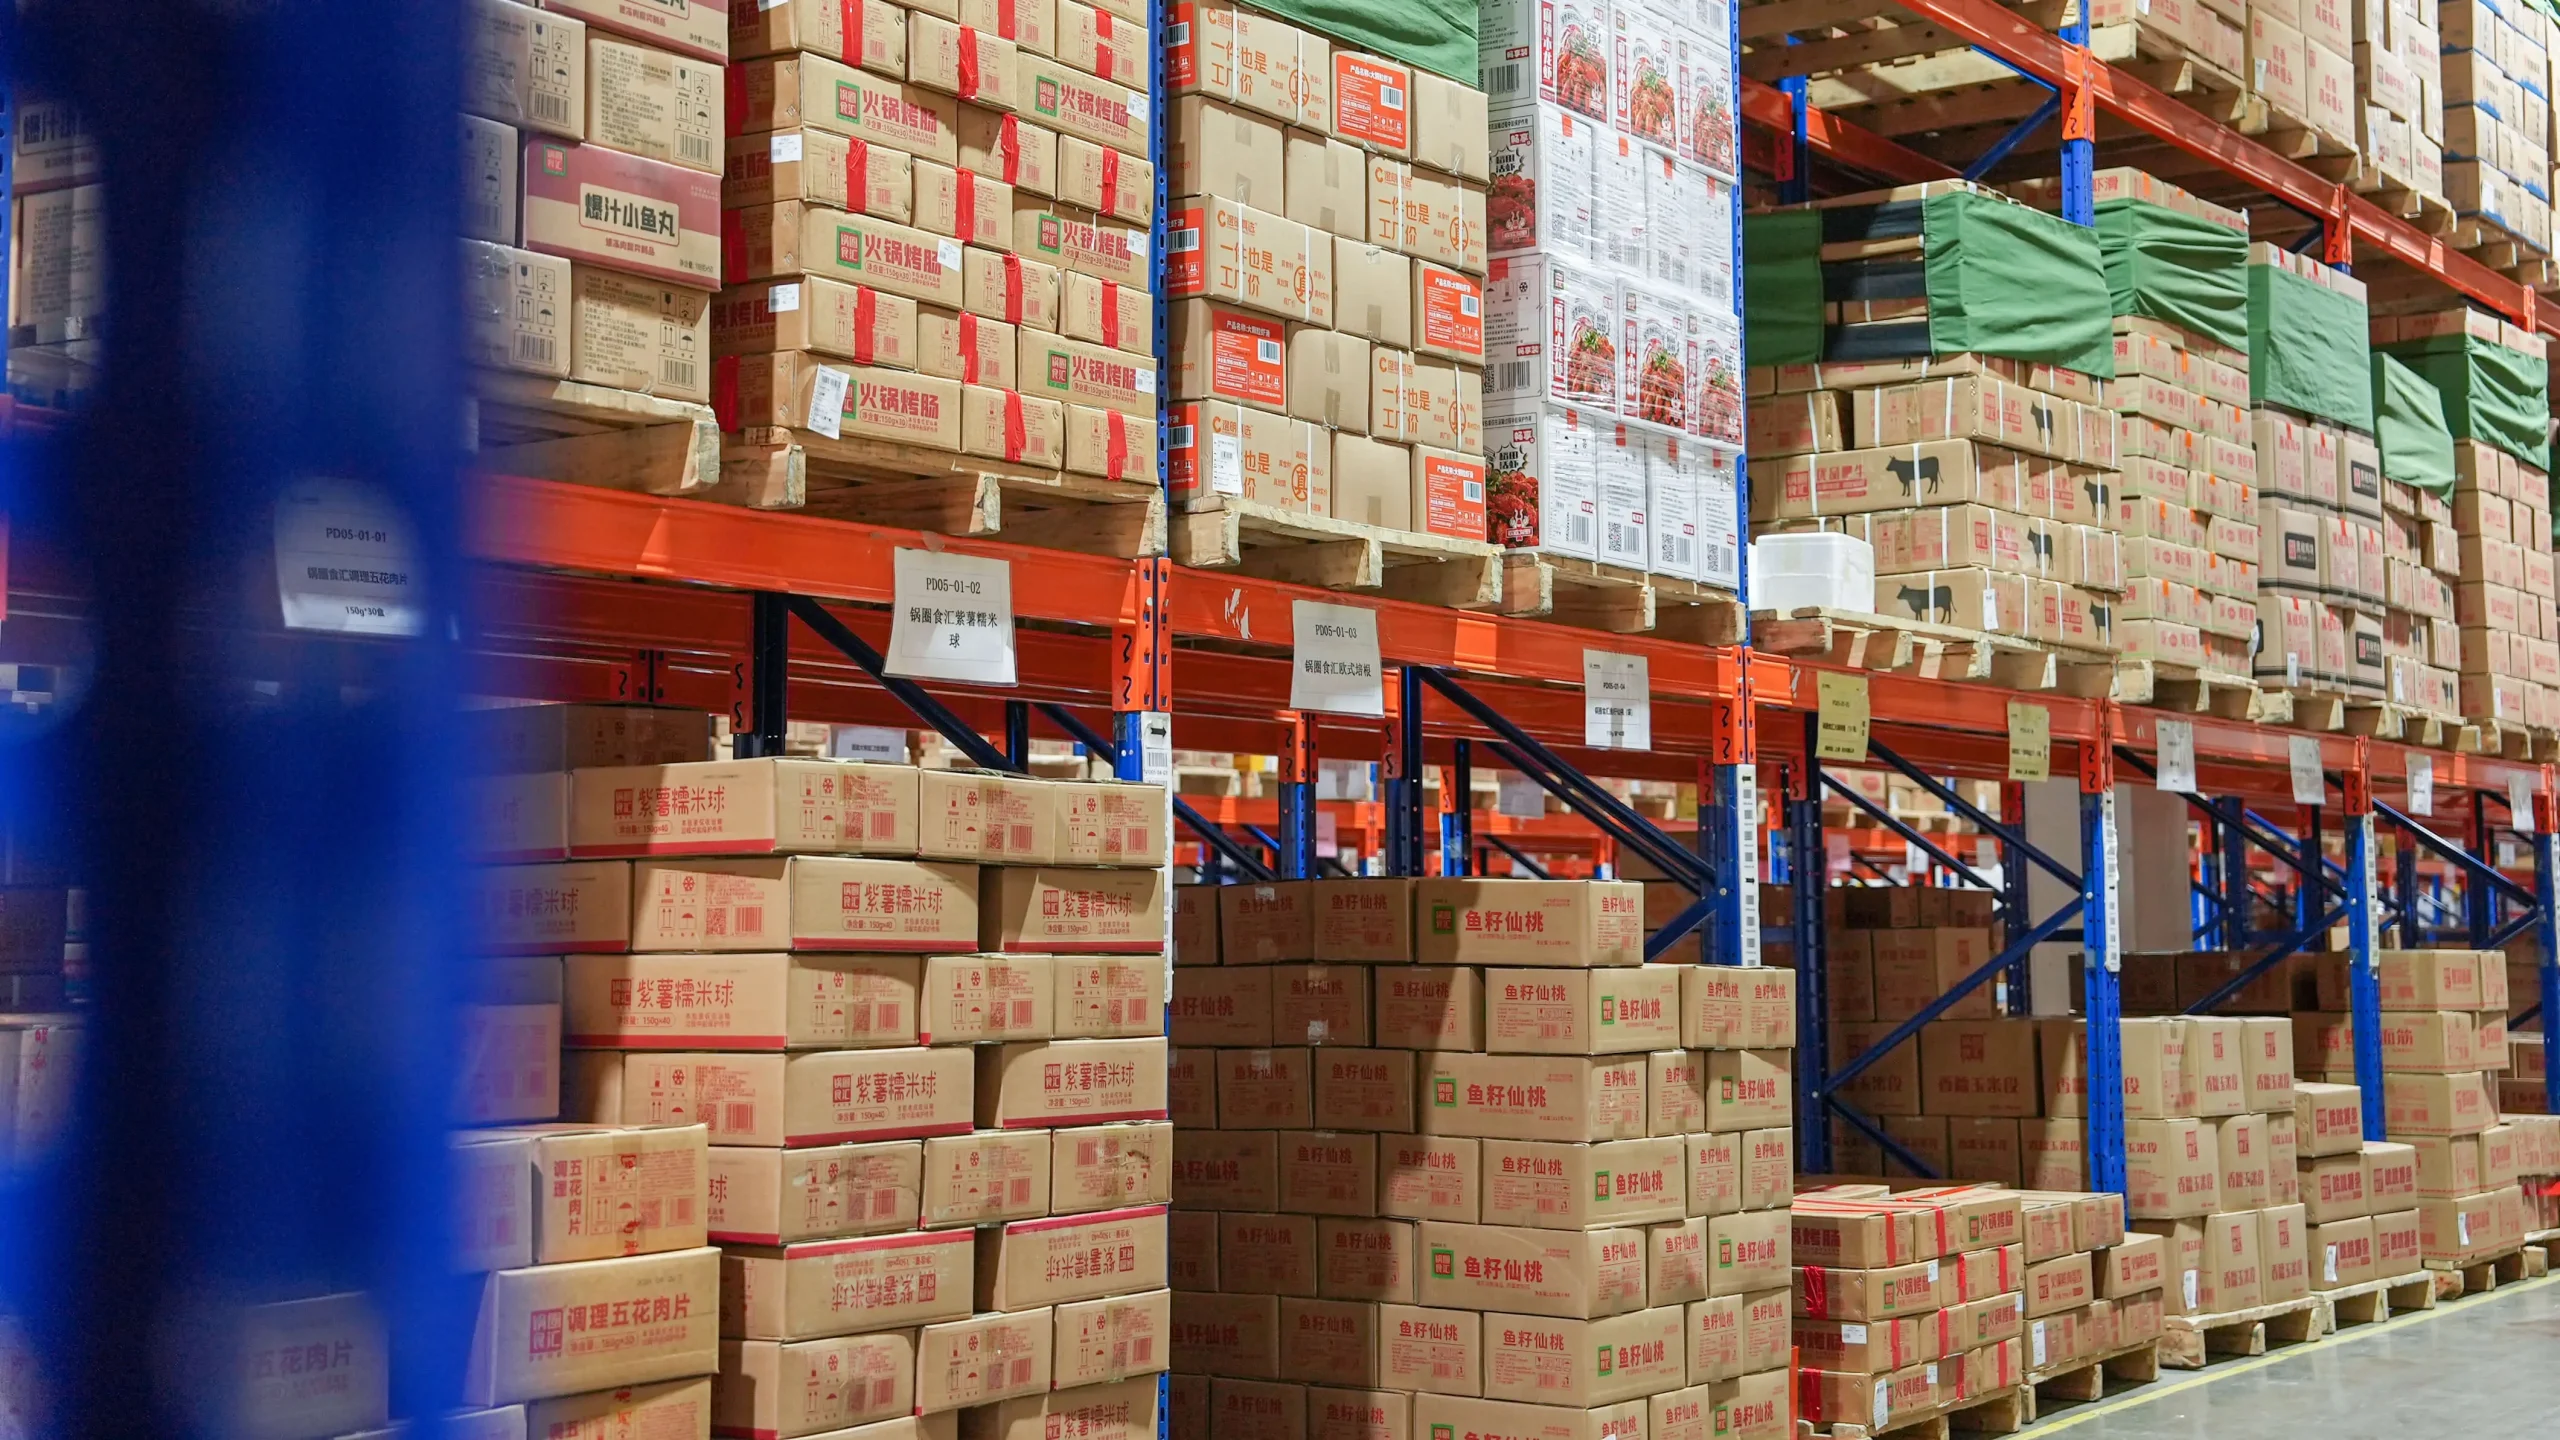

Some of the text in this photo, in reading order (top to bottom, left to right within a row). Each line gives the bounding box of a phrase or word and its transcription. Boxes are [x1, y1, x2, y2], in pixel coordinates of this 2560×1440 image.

[1211, 62, 1253, 96] 工厂价
[863, 89, 937, 134] 火锅烤肠
[1061, 83, 1129, 128] 火锅烤肠
[584, 192, 676, 238] 爆汁小鱼丸
[1063, 221, 1131, 261] 火锅烤肠
[1379, 218, 1417, 246] 工厂价
[865, 234, 941, 275] 火锅烤肠
[1220, 265, 1260, 298] 工厂价
[1072, 355, 1136, 391] 火锅烤肠
[860, 382, 939, 420] 火锅烤肠
[1383, 408, 1419, 434] 工厂价
[1244, 450, 1270, 475] 也是
[1294, 468, 1307, 496] 真
[326, 527, 387, 543] PD05-01-01
[925, 576, 981, 595] PD05-01-02
[909, 606, 998, 630] 锅圈食汇紫薯糯米
[948, 632, 960, 648] 球
[1315, 623, 1357, 639] PD05-01-03
[1304, 659, 1372, 678] 锅圈食汇欧式培根
[637, 785, 725, 817] 紫薯糯米球
[864, 885, 943, 915] 紫薯糯米球
[1063, 890, 1133, 918] 紫薯糯米球
[1331, 894, 1388, 910] 鱼籽仙桃
[1601, 897, 1635, 913] 鱼籽仙桃
[1465, 909, 1544, 933] 鱼籽仙桃
[637, 979, 734, 1009] 紫薯糯米球
[1392, 981, 1450, 998] 鱼籽仙桃
[1504, 984, 1566, 1001] 鱼籽仙桃
[1707, 982, 1739, 998] 鱼籽仙桃
[1754, 984, 1786, 999] 鱼籽仙桃
[1619, 998, 1661, 1020] 鱼籽仙桃
[1065, 1061, 1135, 1091] 紫薯糯米球
[1331, 1063, 1388, 1082] 鱼籽仙桃
[1604, 1070, 1636, 1086] 鱼籽仙桃
[1665, 1066, 1696, 1083] 鱼籽仙桃
[856, 1071, 937, 1105] 紫薯糯米球
[1467, 1084, 1547, 1107] 鱼籽仙桃
[1738, 1078, 1775, 1099] 鱼籽仙桃
[1398, 1150, 1456, 1169] 鱼籽仙桃
[1700, 1148, 1730, 1164] 鱼籽仙桃
[1755, 1142, 1784, 1159] 鱼籽仙桃
[1501, 1156, 1563, 1176] 鱼籽仙桃
[708, 1174, 728, 1201] 球
[1615, 1170, 1663, 1195] 鱼籽仙桃
[567, 1159, 582, 1236] 五花肉片
[1980, 1210, 2013, 1230] 火锅烤肠
[1335, 1232, 1392, 1251] 鱼籽仙桃
[1602, 1243, 1637, 1261] 鱼籽仙桃
[1665, 1233, 1699, 1253] 鱼籽仙桃
[1737, 1239, 1775, 1262] 鱼籽仙桃
[1464, 1256, 1543, 1283] 鱼籽仙桃
[567, 1293, 691, 1333] 调理五花肉片
[1702, 1313, 1734, 1331] 鱼籽仙桃
[1753, 1304, 1783, 1321] 鱼籽仙桃
[1399, 1320, 1458, 1341] 鱼籽仙桃
[1503, 1329, 1564, 1351] 鱼籽仙桃
[1618, 1341, 1664, 1368] 鱼籽仙桃
[1064, 1402, 1130, 1439] 紫薯糯米球
[1666, 1402, 1699, 1424] 鱼籽仙桃
[1733, 1401, 1773, 1428] 鱼籽仙桃
[1602, 1416, 1637, 1436] 鱼籽仙桃
